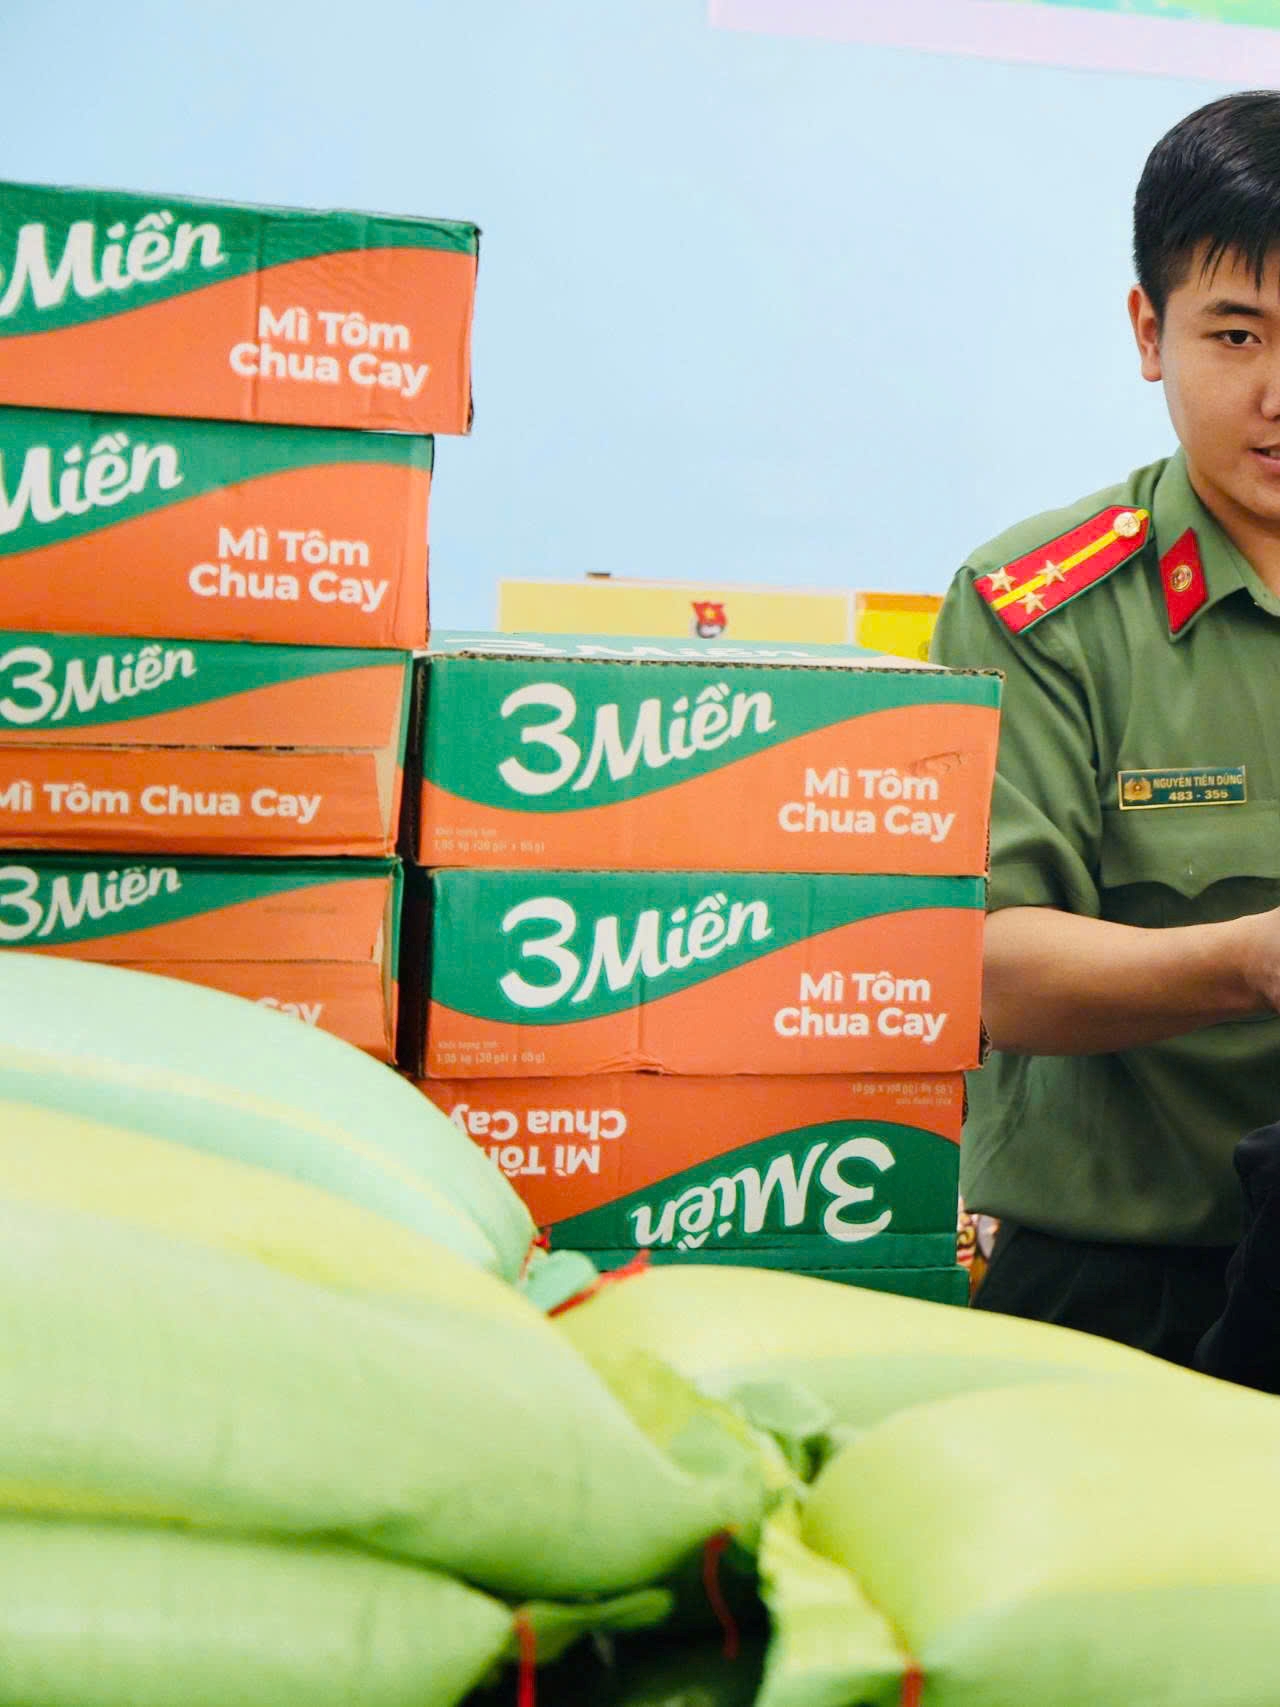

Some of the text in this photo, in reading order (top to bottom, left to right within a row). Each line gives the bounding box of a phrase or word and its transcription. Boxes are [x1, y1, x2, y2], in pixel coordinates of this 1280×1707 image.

[258, 306, 410, 351] Mì Tôm
[229, 343, 430, 398] Chua Cay
[218, 527, 370, 567] Mì Tôm
[189, 565, 390, 613] Chua Cay
[43, 782, 129, 815] Tôm
[140, 784, 240, 817] Chua
[250, 788, 321, 825] Cay
[804, 767, 939, 801] Mì Tôm
[778, 802, 955, 844] Chua Cay
[799, 971, 931, 1003] Mì Tôm
[254, 997, 323, 1027] ay
[774, 1006, 948, 1044] Chua Cay
[526, 1109, 627, 1141] Chua
[554, 1144, 600, 1177] Mì
